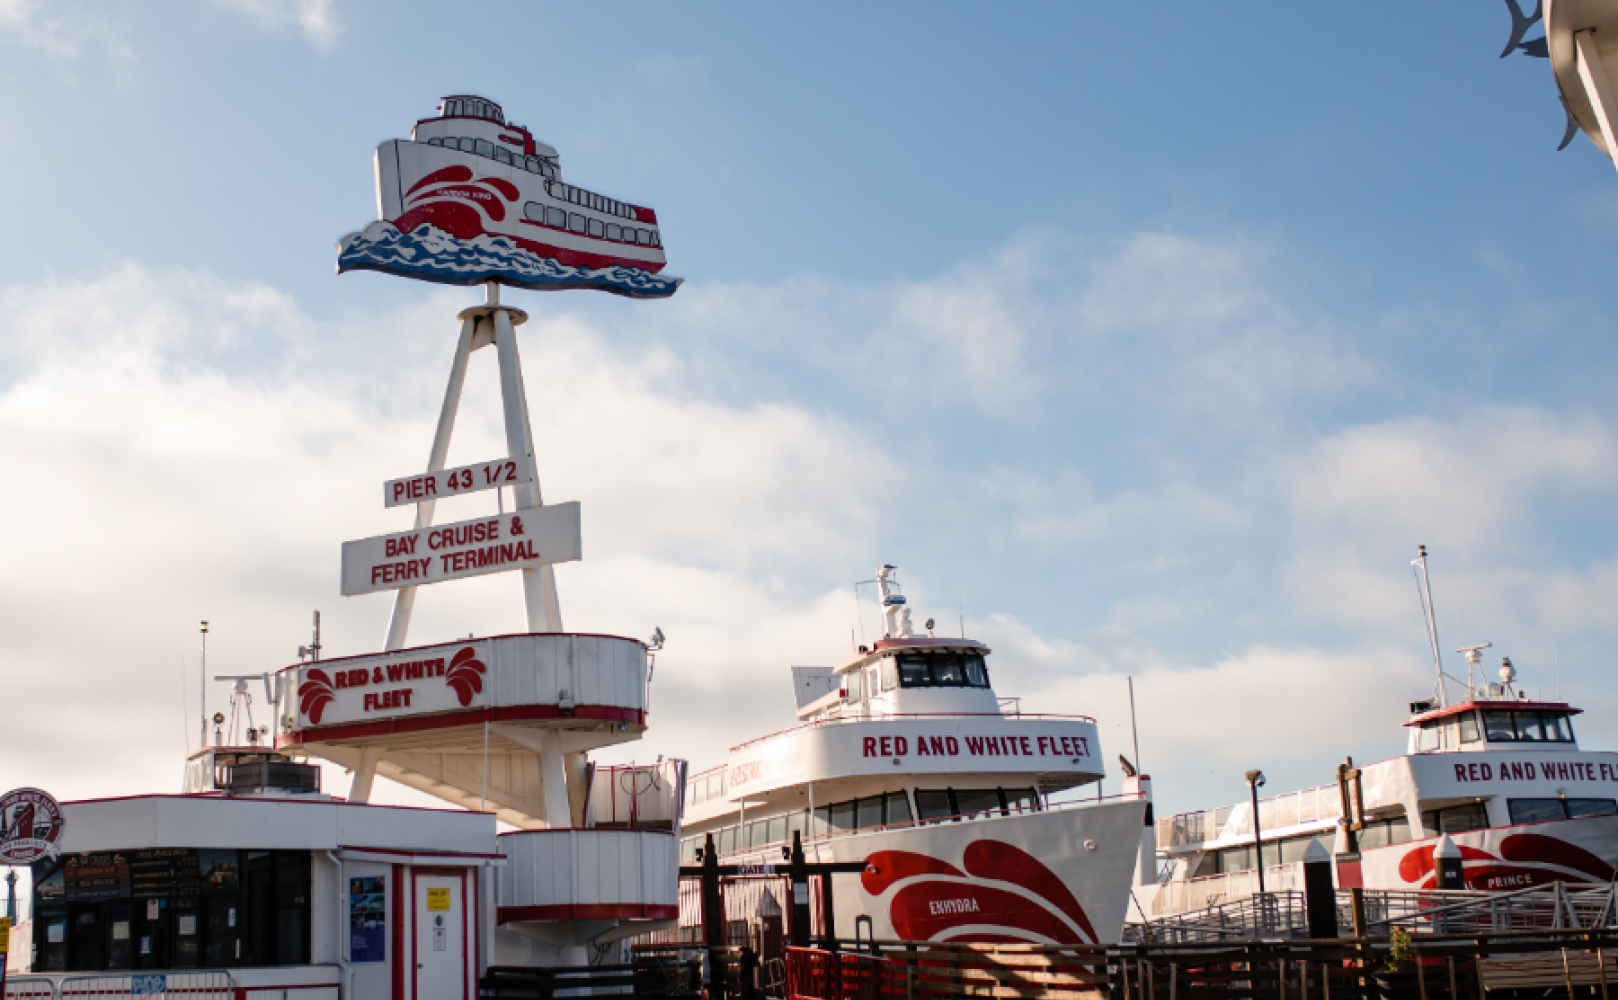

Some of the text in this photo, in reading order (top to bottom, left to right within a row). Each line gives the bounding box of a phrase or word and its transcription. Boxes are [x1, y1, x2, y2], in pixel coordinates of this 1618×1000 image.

[472, 191, 492, 200] KING
[393, 461, 517, 502] PIER 43 1/2
[385, 516, 525, 558] BAY CRUISE &
[371, 539, 540, 585] FERRY TERMINAL
[335, 657, 445, 689] RED & WHITE
[363, 688, 413, 712] FLEET
[862, 736, 1091, 758] RED AND WHITE FLEET
[1454, 762, 1618, 782] RED AND WHITE FL
[738, 864, 765, 875] GATE
[1488, 874, 1533, 889] PRINCE
[929, 898, 980, 916] ENHYDRA
